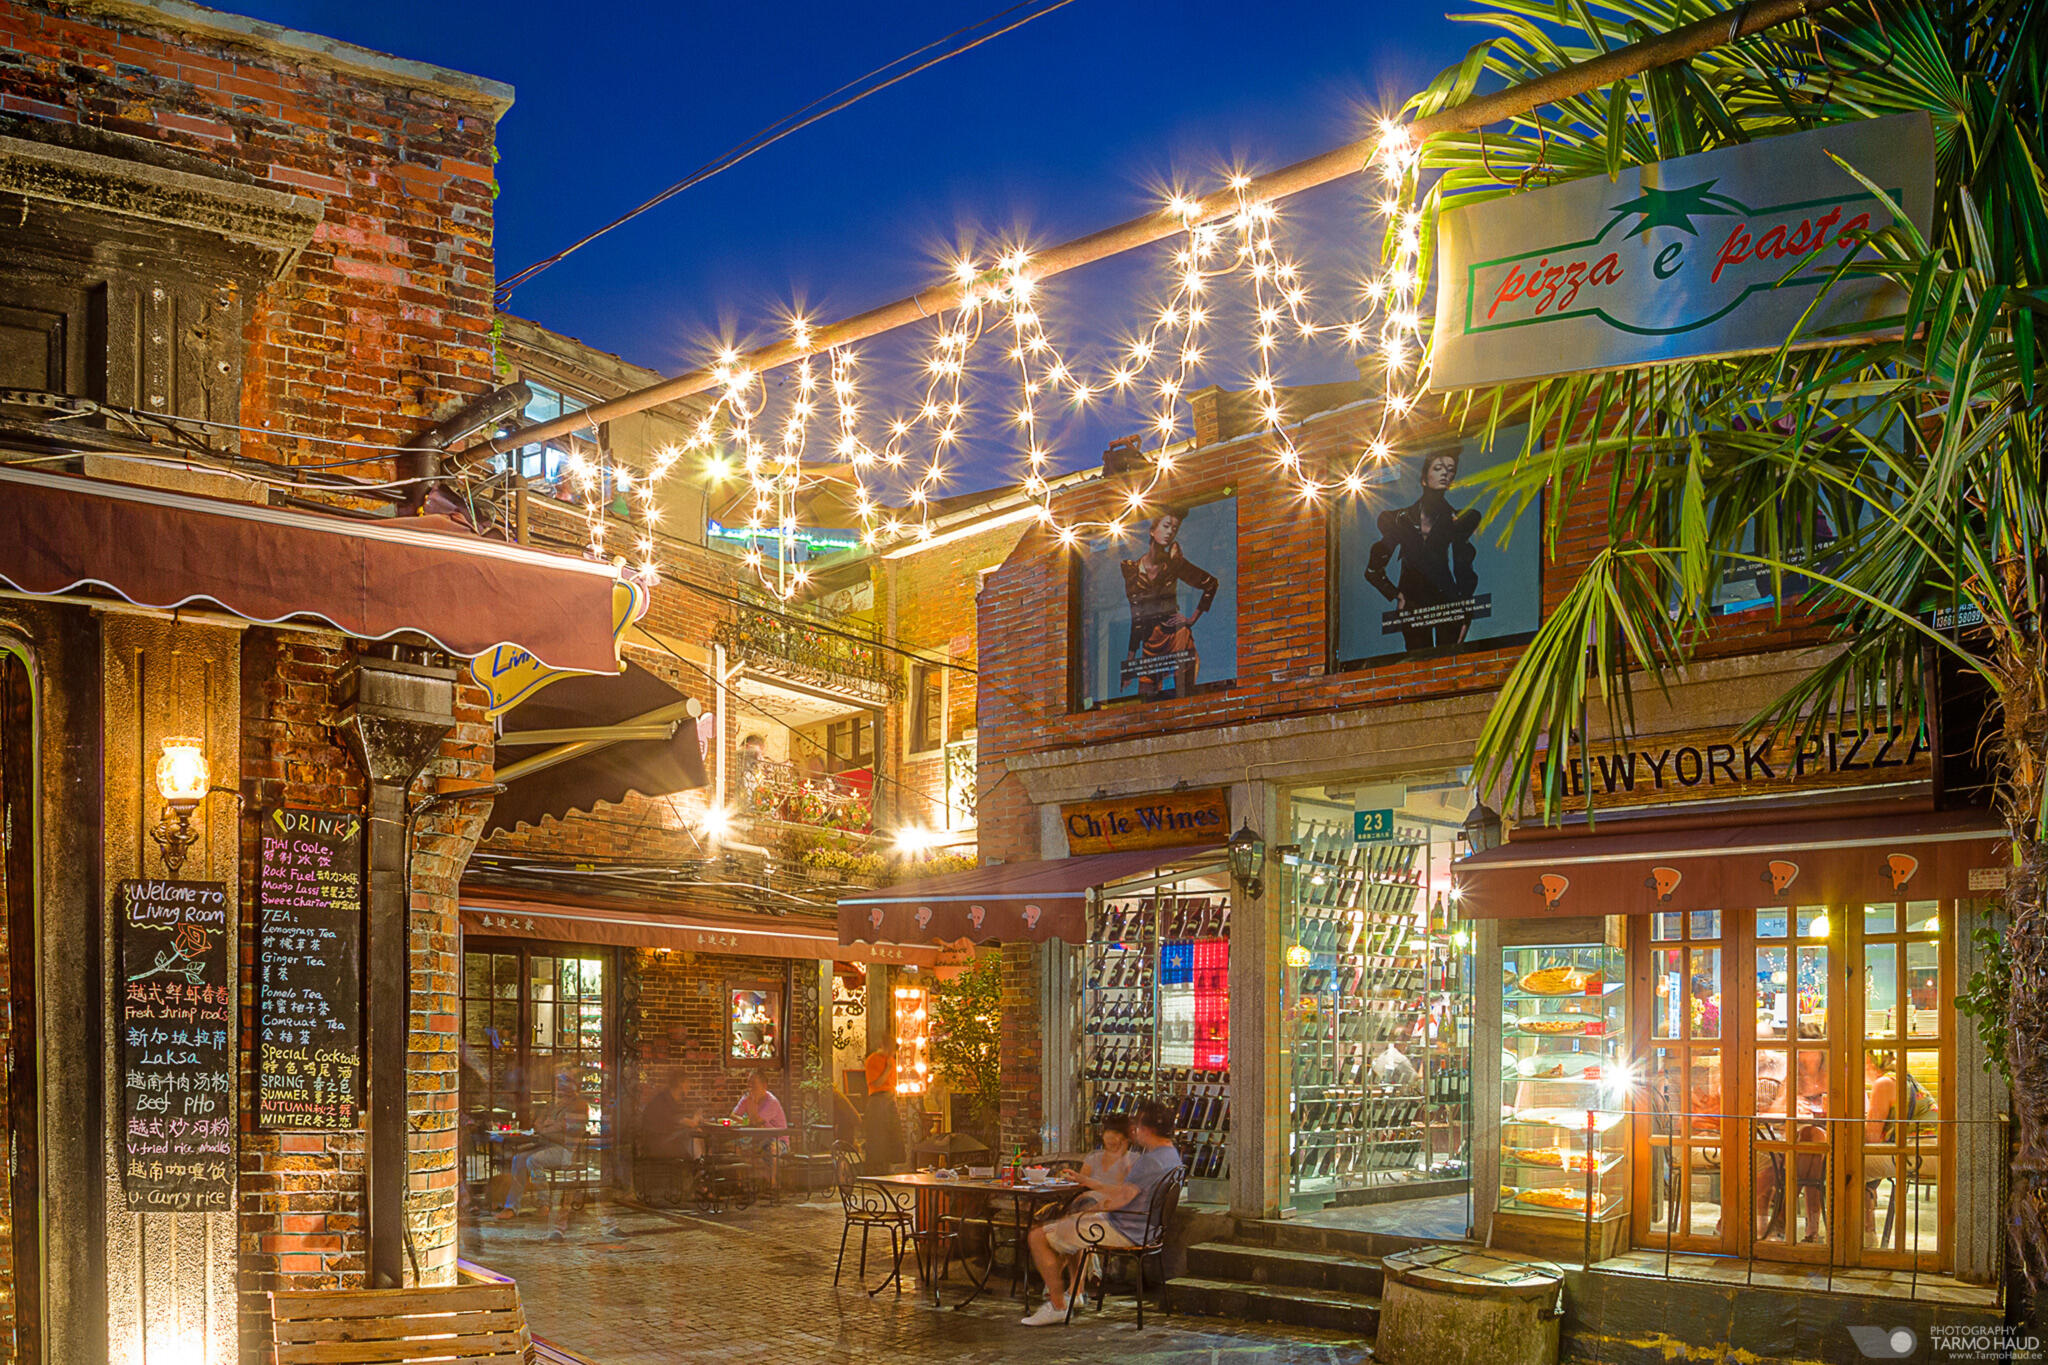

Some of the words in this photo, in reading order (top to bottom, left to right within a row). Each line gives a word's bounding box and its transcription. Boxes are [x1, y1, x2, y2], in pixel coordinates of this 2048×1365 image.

[1487, 252, 1624, 320] pizza
[1652, 241, 1684, 279] e
[1711, 205, 1871, 284] pasta
[492, 645, 541, 678] Livin
[1796, 722, 1932, 776] PIZZA
[285, 813, 346, 837] DRINK
[1135, 805, 1220, 832] Wines
[1364, 813, 1383, 831] 23
[262, 864, 287, 878] Rock
[130, 881, 196, 902] Welcome
[261, 880, 294, 893] Mango
[295, 882, 320, 896] Lassi
[261, 892, 292, 905] Sweet
[133, 902, 180, 925] Living
[185, 907, 224, 924] Room
[261, 922, 315, 938] Lemongrass
[318, 928, 337, 939] Tea
[261, 951, 299, 967] Ginger
[303, 955, 326, 967] Tea
[261, 984, 297, 998] Pomelo
[302, 988, 323, 1000] Tea
[124, 1004, 155, 1020] Fresh
[324, 1019, 346, 1031] Tea
[126, 1068, 230, 1093] 越南牛肉汤粉
[261, 1073, 305, 1089] SPRING
[136, 1090, 171, 1114] Beef
[260, 1087, 309, 1101] SUMMER
[260, 1099, 313, 1113] AUTUMN
[128, 1116, 230, 1138] 越式炒河粉
[260, 1113, 312, 1127] WINTER
[196, 1190, 226, 1208] rice
